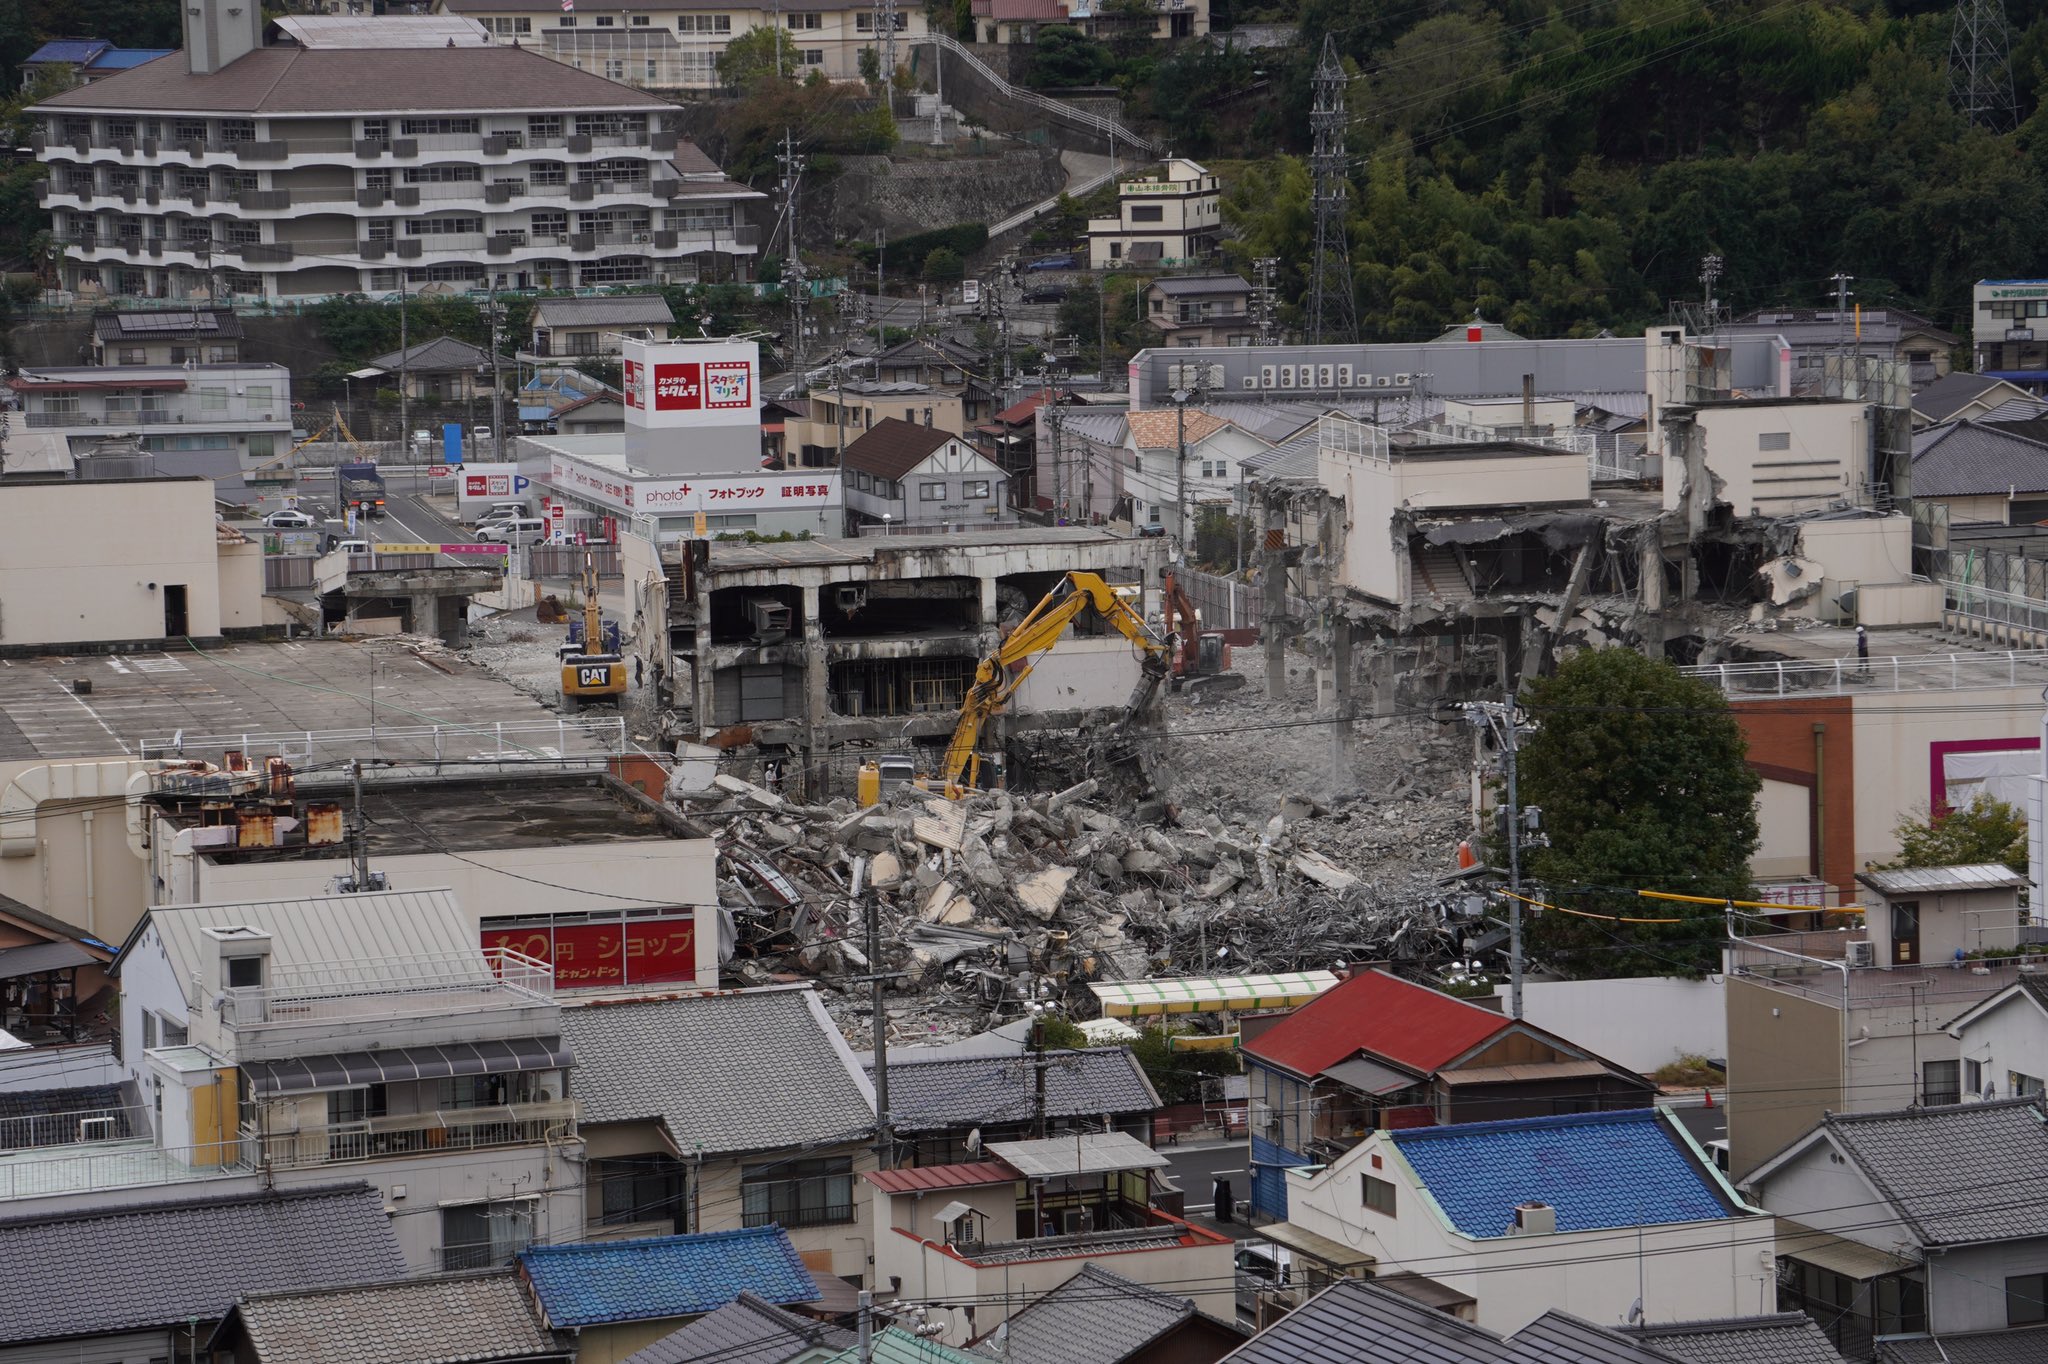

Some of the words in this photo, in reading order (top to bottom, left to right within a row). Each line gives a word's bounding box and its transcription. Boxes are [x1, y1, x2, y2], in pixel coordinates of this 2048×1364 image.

[658, 377, 687, 385] カメラの
[709, 374, 746, 386] スタジオ
[657, 384, 698, 397] キタムラ
[714, 385, 740, 398] マリオ
[514, 475, 530, 494] P
[708, 486, 765, 500] フォトブック
[781, 484, 829, 498] 証明写真
[581, 668, 607, 685] CAT
[598, 928, 694, 959] ショップ
[556, 966, 620, 979] キャン・ドゥ
